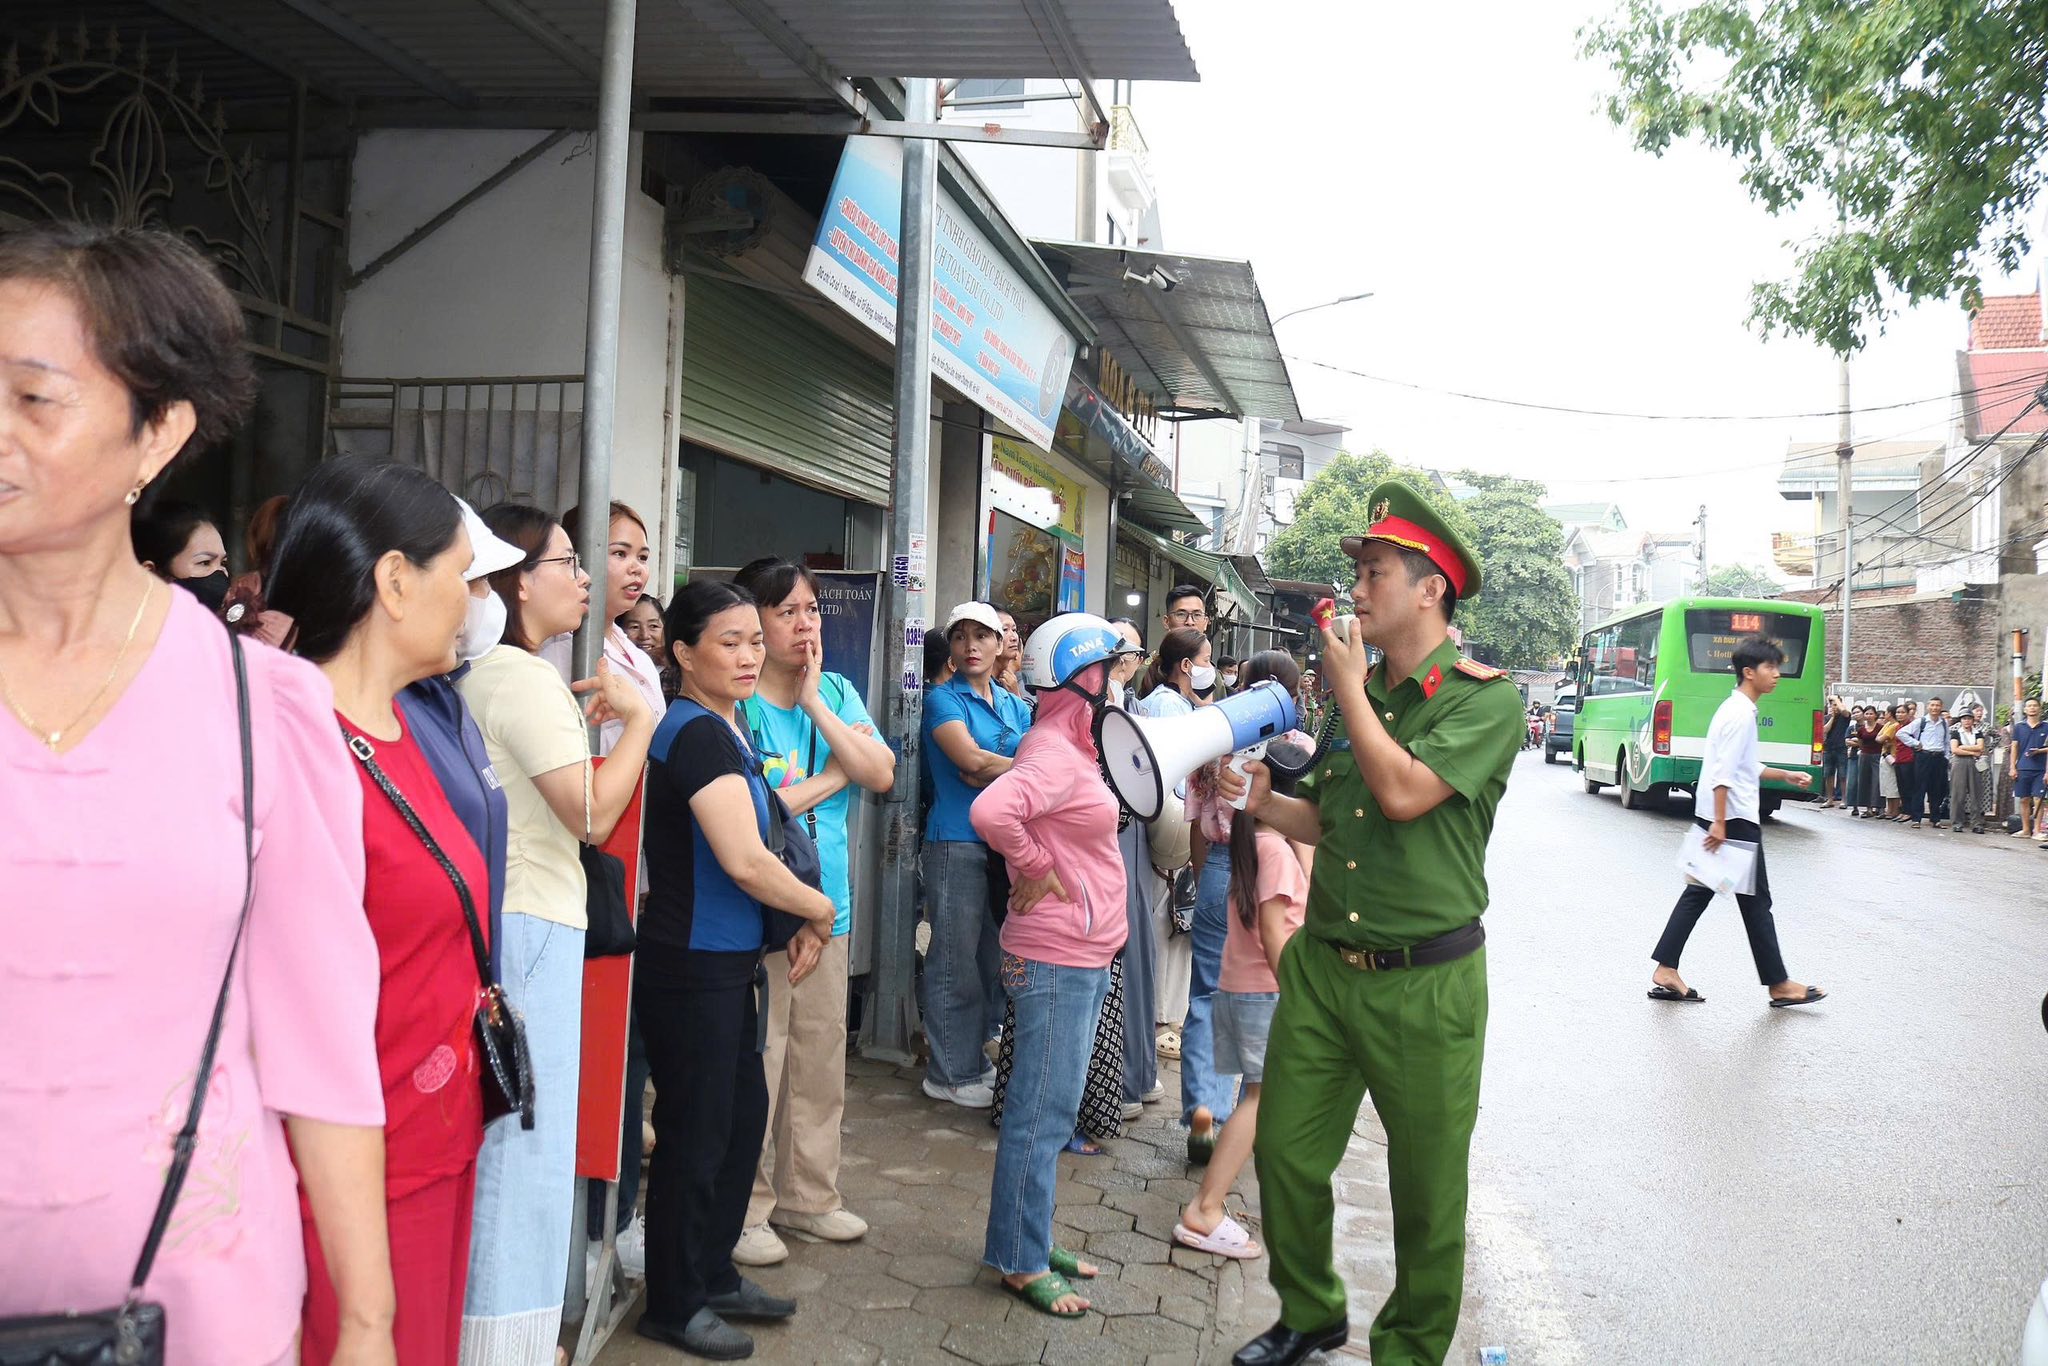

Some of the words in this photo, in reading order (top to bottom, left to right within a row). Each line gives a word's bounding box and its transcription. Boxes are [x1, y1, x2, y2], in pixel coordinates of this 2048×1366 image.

[942, 214, 964, 248] TNHH
[963, 237, 981, 266] GIÁO
[979, 255, 995, 280] DỤC
[993, 269, 1011, 297] BÁCH
[1009, 286, 1026, 312] TOÁN
[946, 254, 966, 283] TOAN
[964, 273, 981, 299] EDU
[845, 587, 872, 600] TOÁN
[1731, 613, 1760, 630] 114
